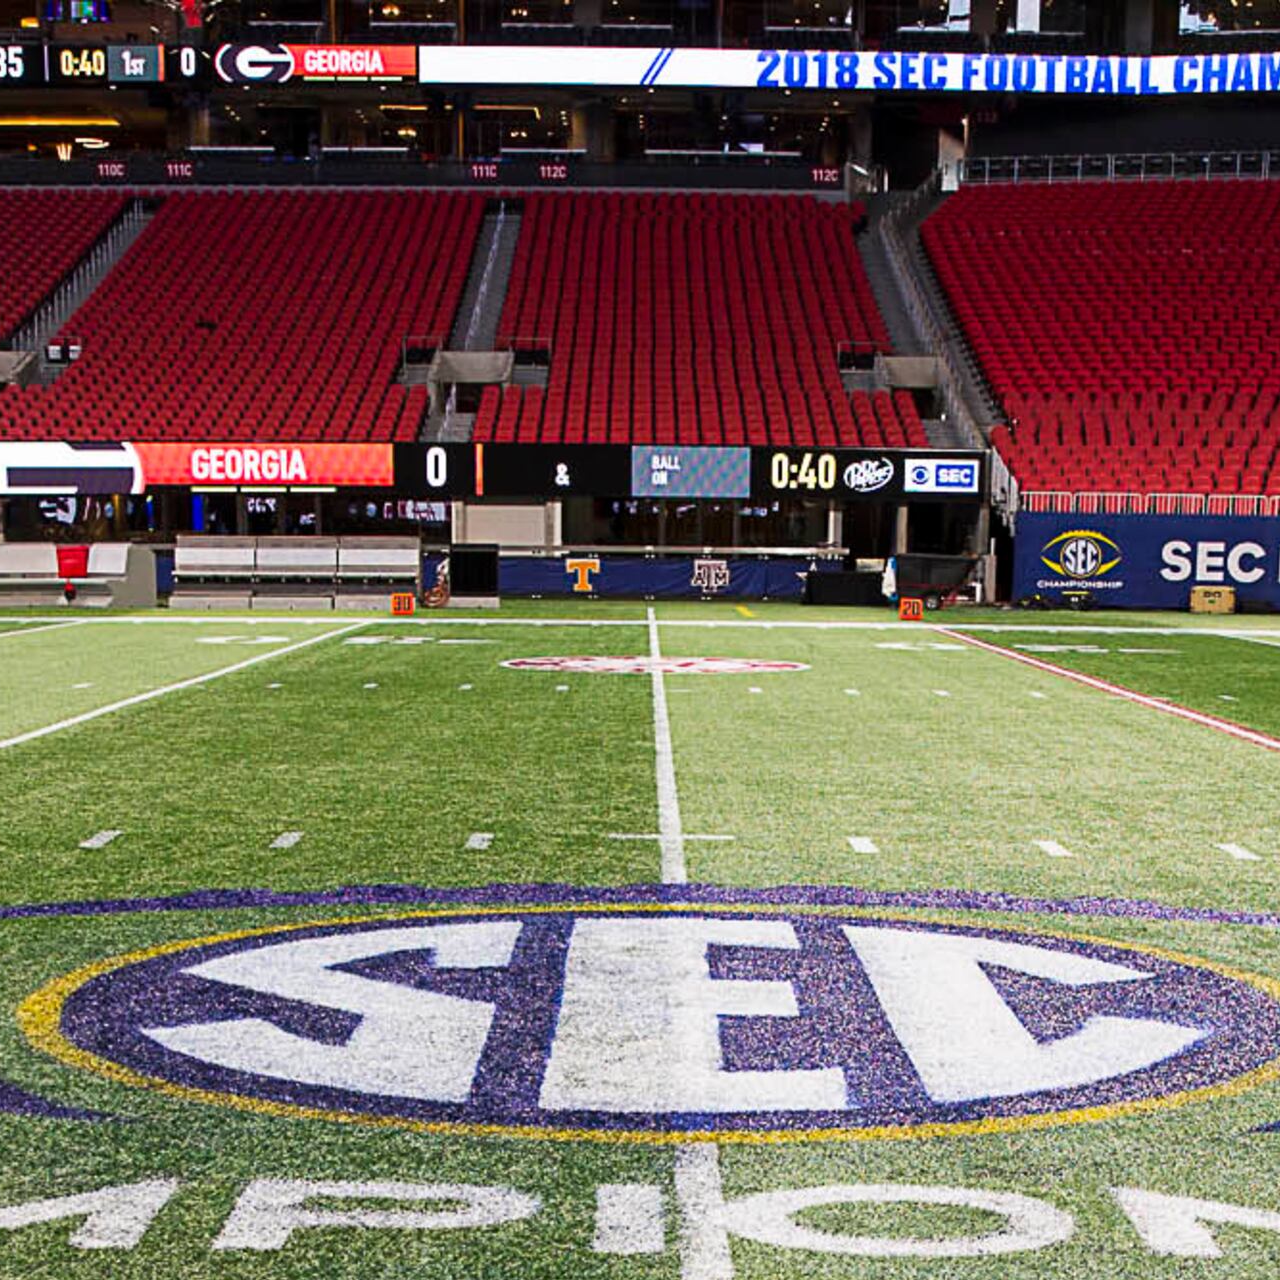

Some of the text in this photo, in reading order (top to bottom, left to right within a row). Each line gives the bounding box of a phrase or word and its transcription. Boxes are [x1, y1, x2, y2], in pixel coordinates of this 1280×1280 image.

[60, 50, 106, 76] 0:40
[181, 47, 195, 76] 0
[304, 49, 383, 73] GEORGIA
[757, 50, 860, 89] 2018
[873, 52, 947, 90] SEC
[962, 53, 1159, 94] FOOTBALL
[167, 164, 192, 176] 111C
[472, 164, 497, 177] 111C
[540, 166, 567, 178] 112C
[812, 169, 838, 182] 112C
[191, 449, 307, 480] GEORGIA
[426, 446, 447, 487] 0
[555, 462, 570, 486] &
[652, 456, 681, 470] BALL
[771, 453, 837, 489] 0:40
[937, 468, 972, 484] SEC
[1064, 540, 1099, 575] SEC
[1160, 541, 1265, 583] SEC
[566, 558, 601, 592] T
[1037, 579, 1124, 588] CHAMPIONSHIP
[903, 601, 921, 616] 20
[136, 915, 1210, 1113] SEC
